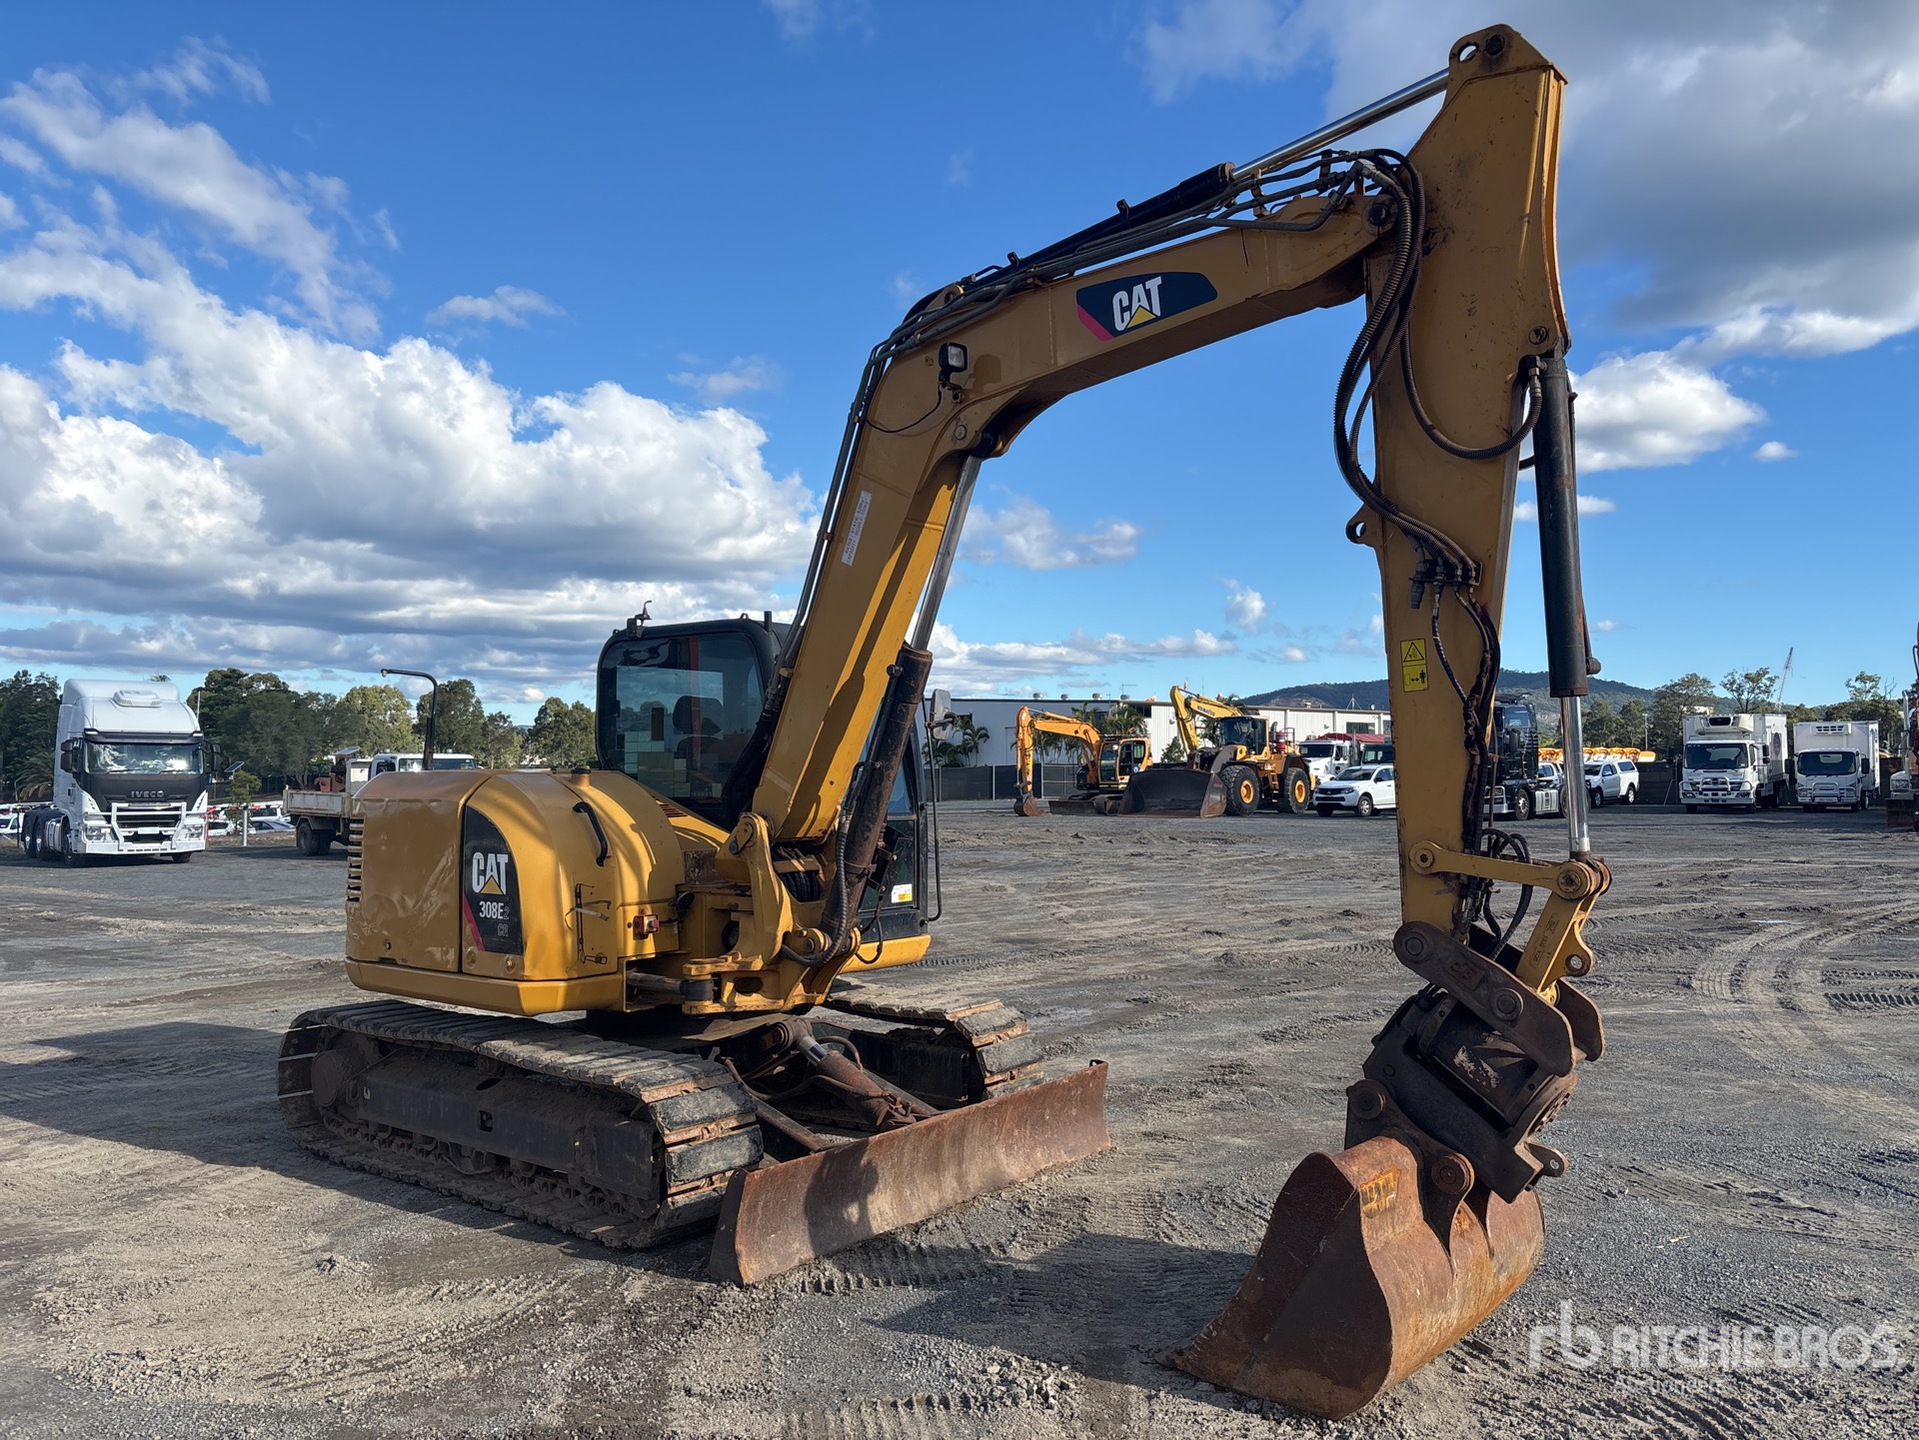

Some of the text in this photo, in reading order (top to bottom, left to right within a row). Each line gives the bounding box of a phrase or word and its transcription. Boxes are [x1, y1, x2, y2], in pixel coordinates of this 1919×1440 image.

[1112, 276, 1162, 331] CAT
[131, 790, 165, 798] IVECO
[472, 851, 508, 895] CAT
